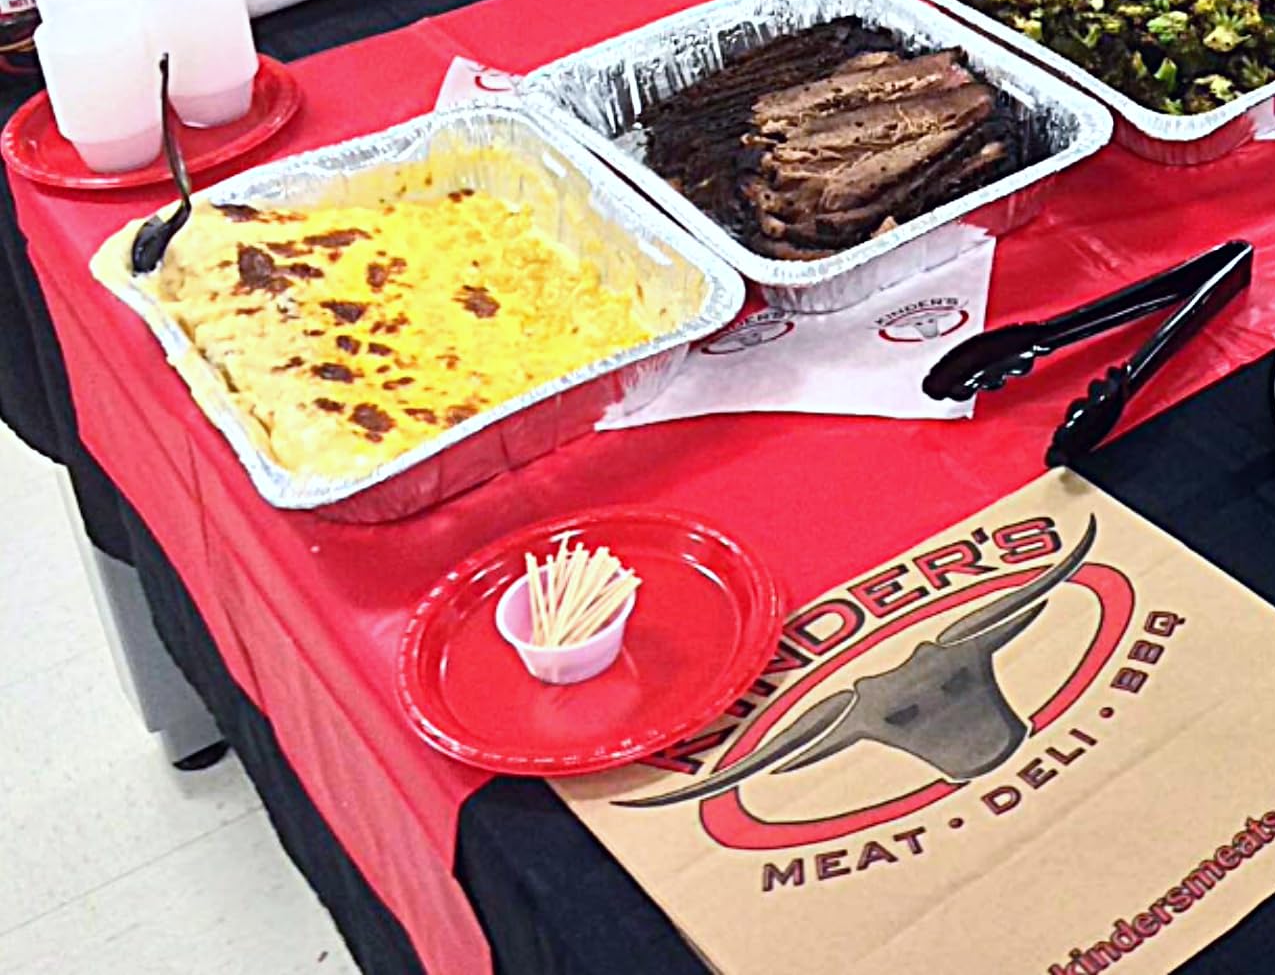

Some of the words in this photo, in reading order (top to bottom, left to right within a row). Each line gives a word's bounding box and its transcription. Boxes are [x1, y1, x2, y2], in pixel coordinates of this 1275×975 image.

[874, 297, 959, 326] KINDER'S
[761, 826, 926, 892] MEAT
[981, 725, 1099, 815] DELI
[1110, 609, 1187, 694] BBQ
